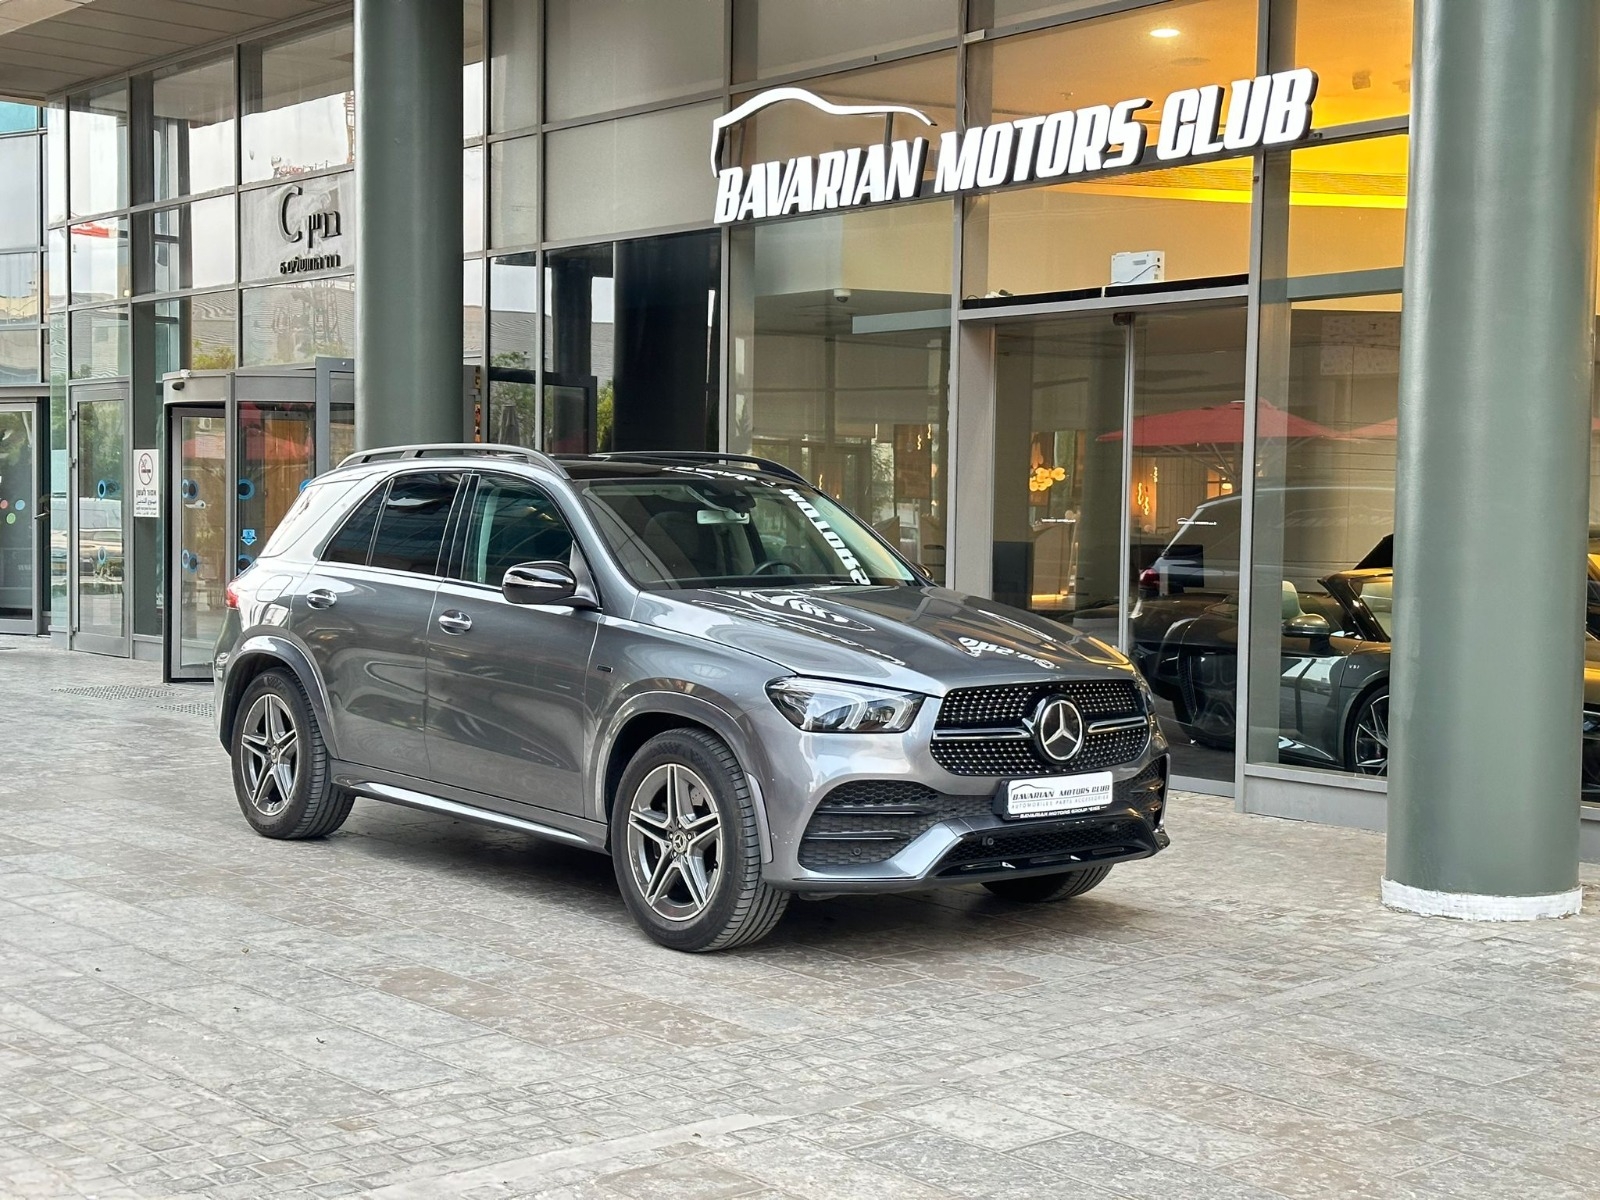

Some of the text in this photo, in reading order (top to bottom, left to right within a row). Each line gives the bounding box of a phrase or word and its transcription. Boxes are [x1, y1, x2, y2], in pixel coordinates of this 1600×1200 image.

[714, 67, 1319, 224] BAVARIAN MOTORS CLUB
[278, 184, 303, 243] C
[1012, 784, 1110, 800] BAVARIAN MOTORS CLUB
